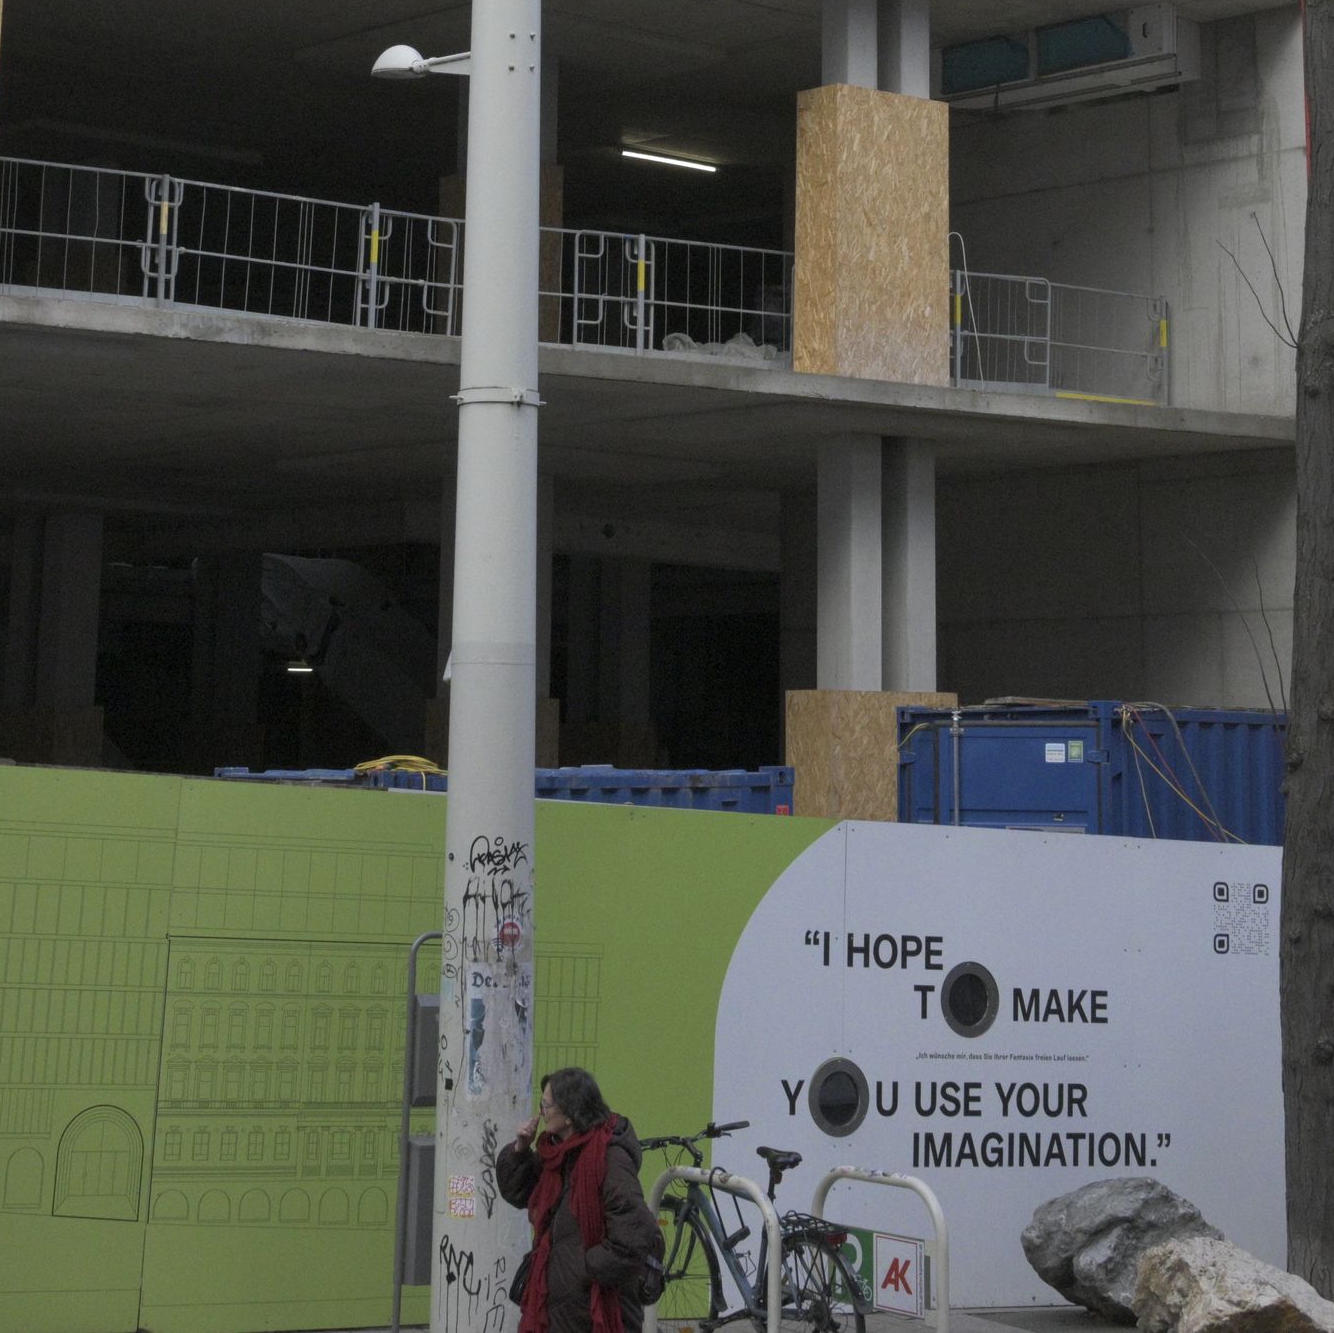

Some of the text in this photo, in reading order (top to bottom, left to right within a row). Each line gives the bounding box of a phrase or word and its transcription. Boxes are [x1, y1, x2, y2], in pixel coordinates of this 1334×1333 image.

[846, 933, 943, 971] HOPE
[1012, 988, 1109, 1024] MAKE
[929, 1052, 955, 1060] wünsche
[1010, 1053, 1034, 1061] Fantasie
[1034, 1054, 1052, 1062] freien
[1053, 1054, 1066, 1062] Lauf
[914, 1081, 982, 1117] USE
[994, 1082, 1087, 1117] YOUR
[912, 1130, 1171, 1168] IMAGINATION.”
[881, 1257, 913, 1295] AK
